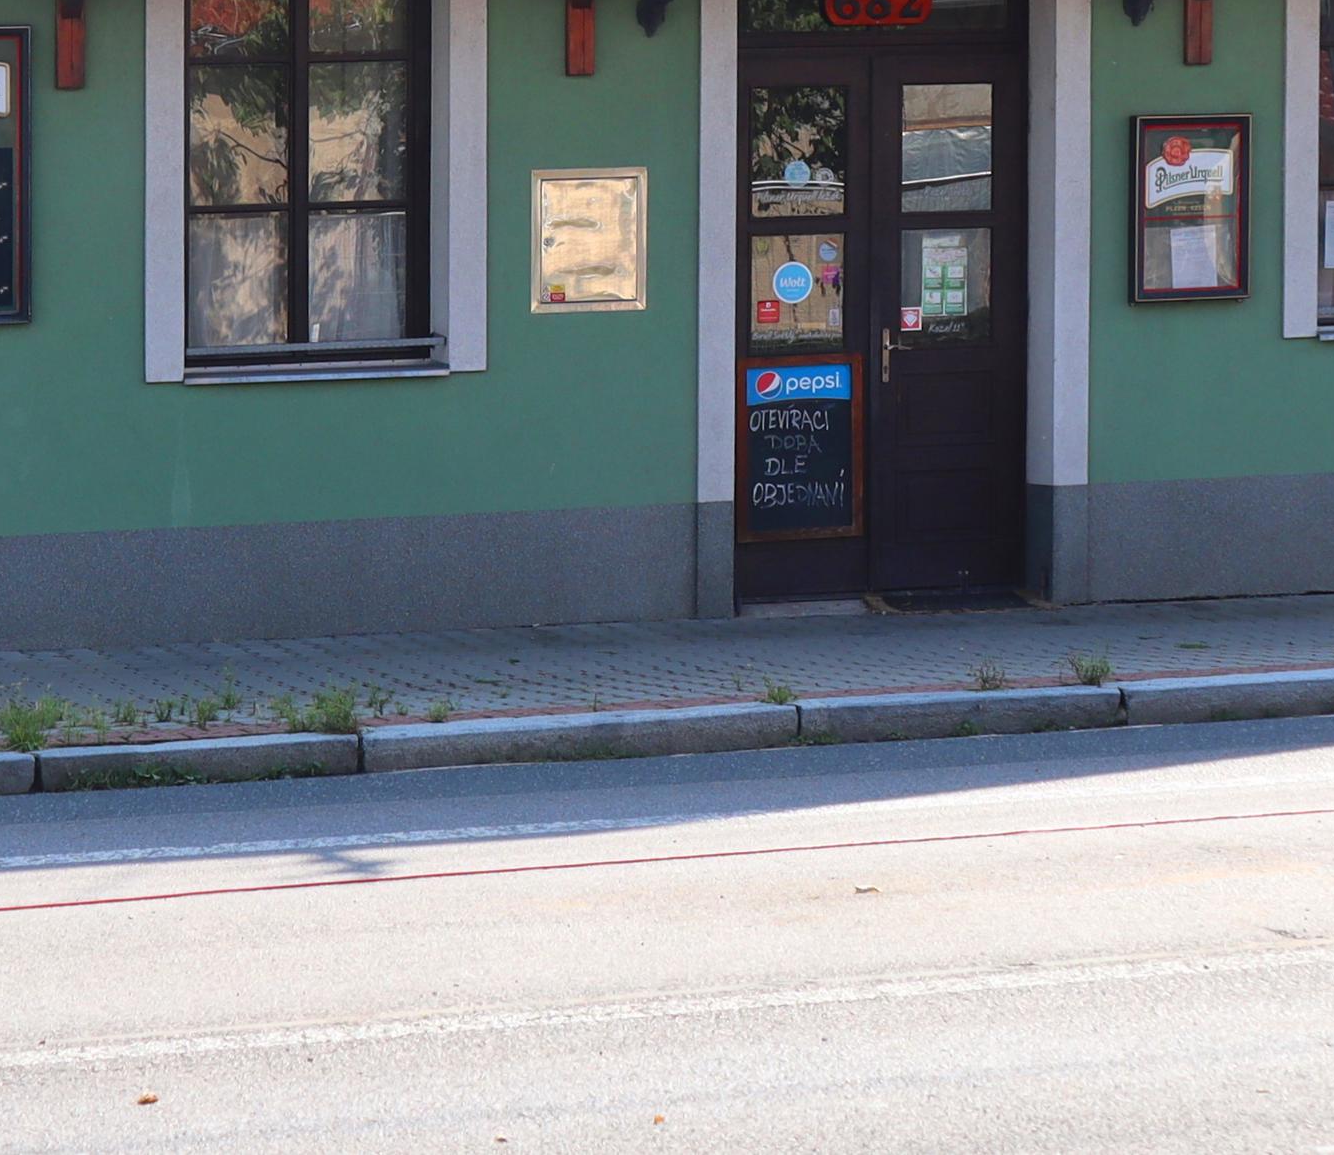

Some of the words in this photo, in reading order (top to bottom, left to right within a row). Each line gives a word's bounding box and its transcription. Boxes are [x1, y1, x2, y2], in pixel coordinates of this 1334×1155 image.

[1155, 167, 1190, 193] Pilsner
[1189, 165, 1223, 184] Urquell
[786, 372, 840, 395] pepsi
[764, 455, 808, 476] DLE
